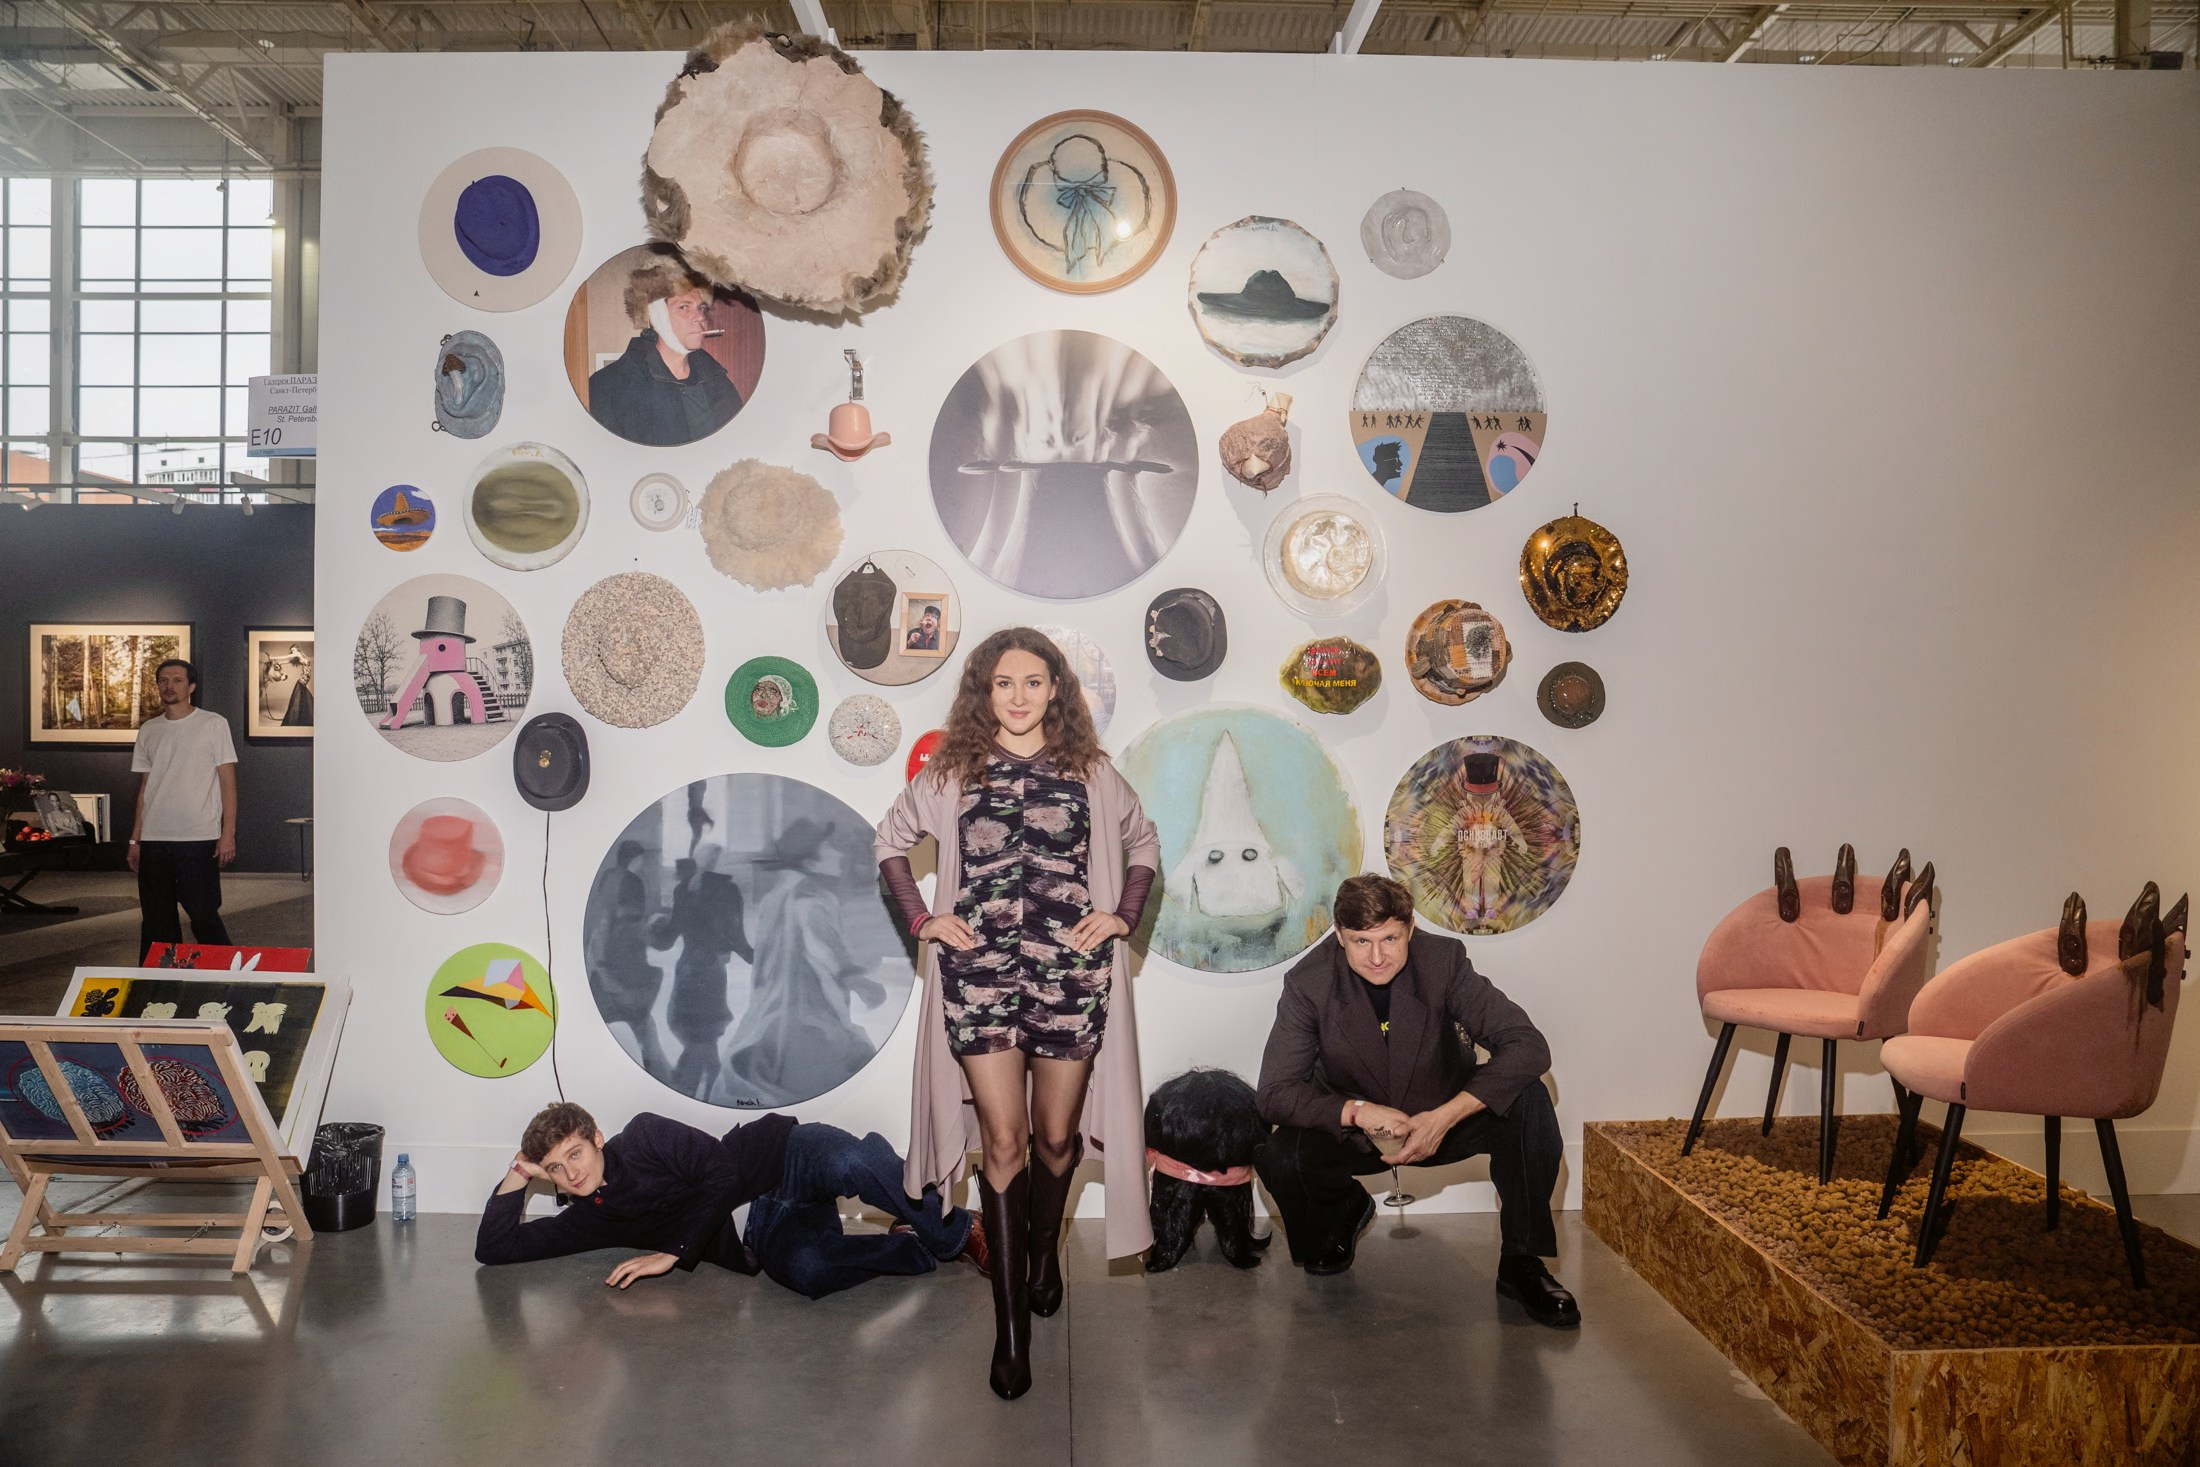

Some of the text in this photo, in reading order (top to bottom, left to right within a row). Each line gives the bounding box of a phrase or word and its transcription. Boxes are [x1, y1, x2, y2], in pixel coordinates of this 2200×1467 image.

[268, 405, 300, 414] PARAZIT
[277, 415, 286, 423] St.
[251, 427, 282, 446] E10
